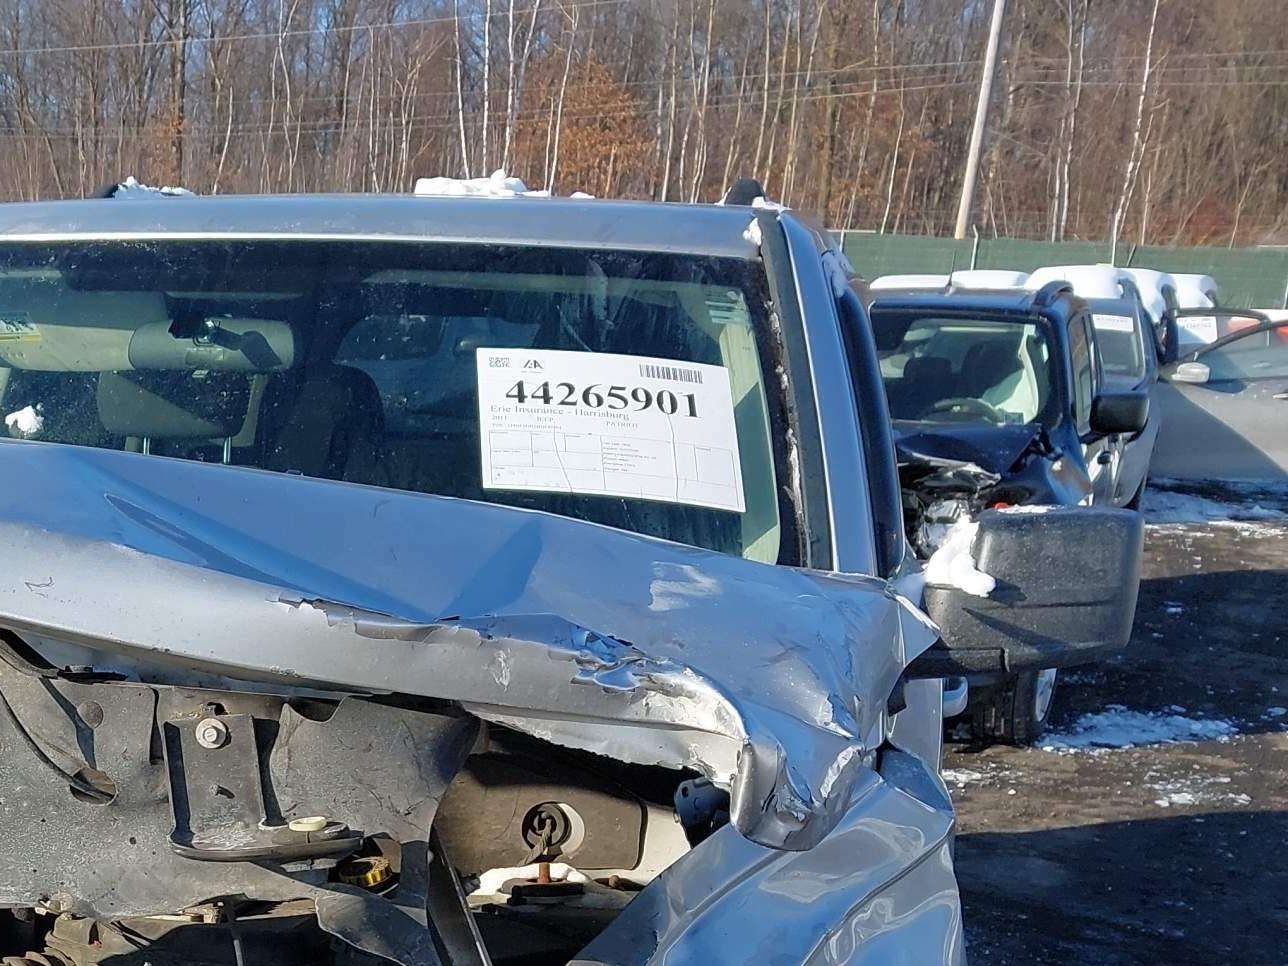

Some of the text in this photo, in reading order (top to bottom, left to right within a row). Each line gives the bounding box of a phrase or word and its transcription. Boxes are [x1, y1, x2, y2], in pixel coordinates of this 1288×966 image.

[490, 404, 512, 413] Erie
[515, 405, 564, 415] Insurance
[574, 408, 630, 421] Harrisburg
[505, 379, 700, 419] 44265901
